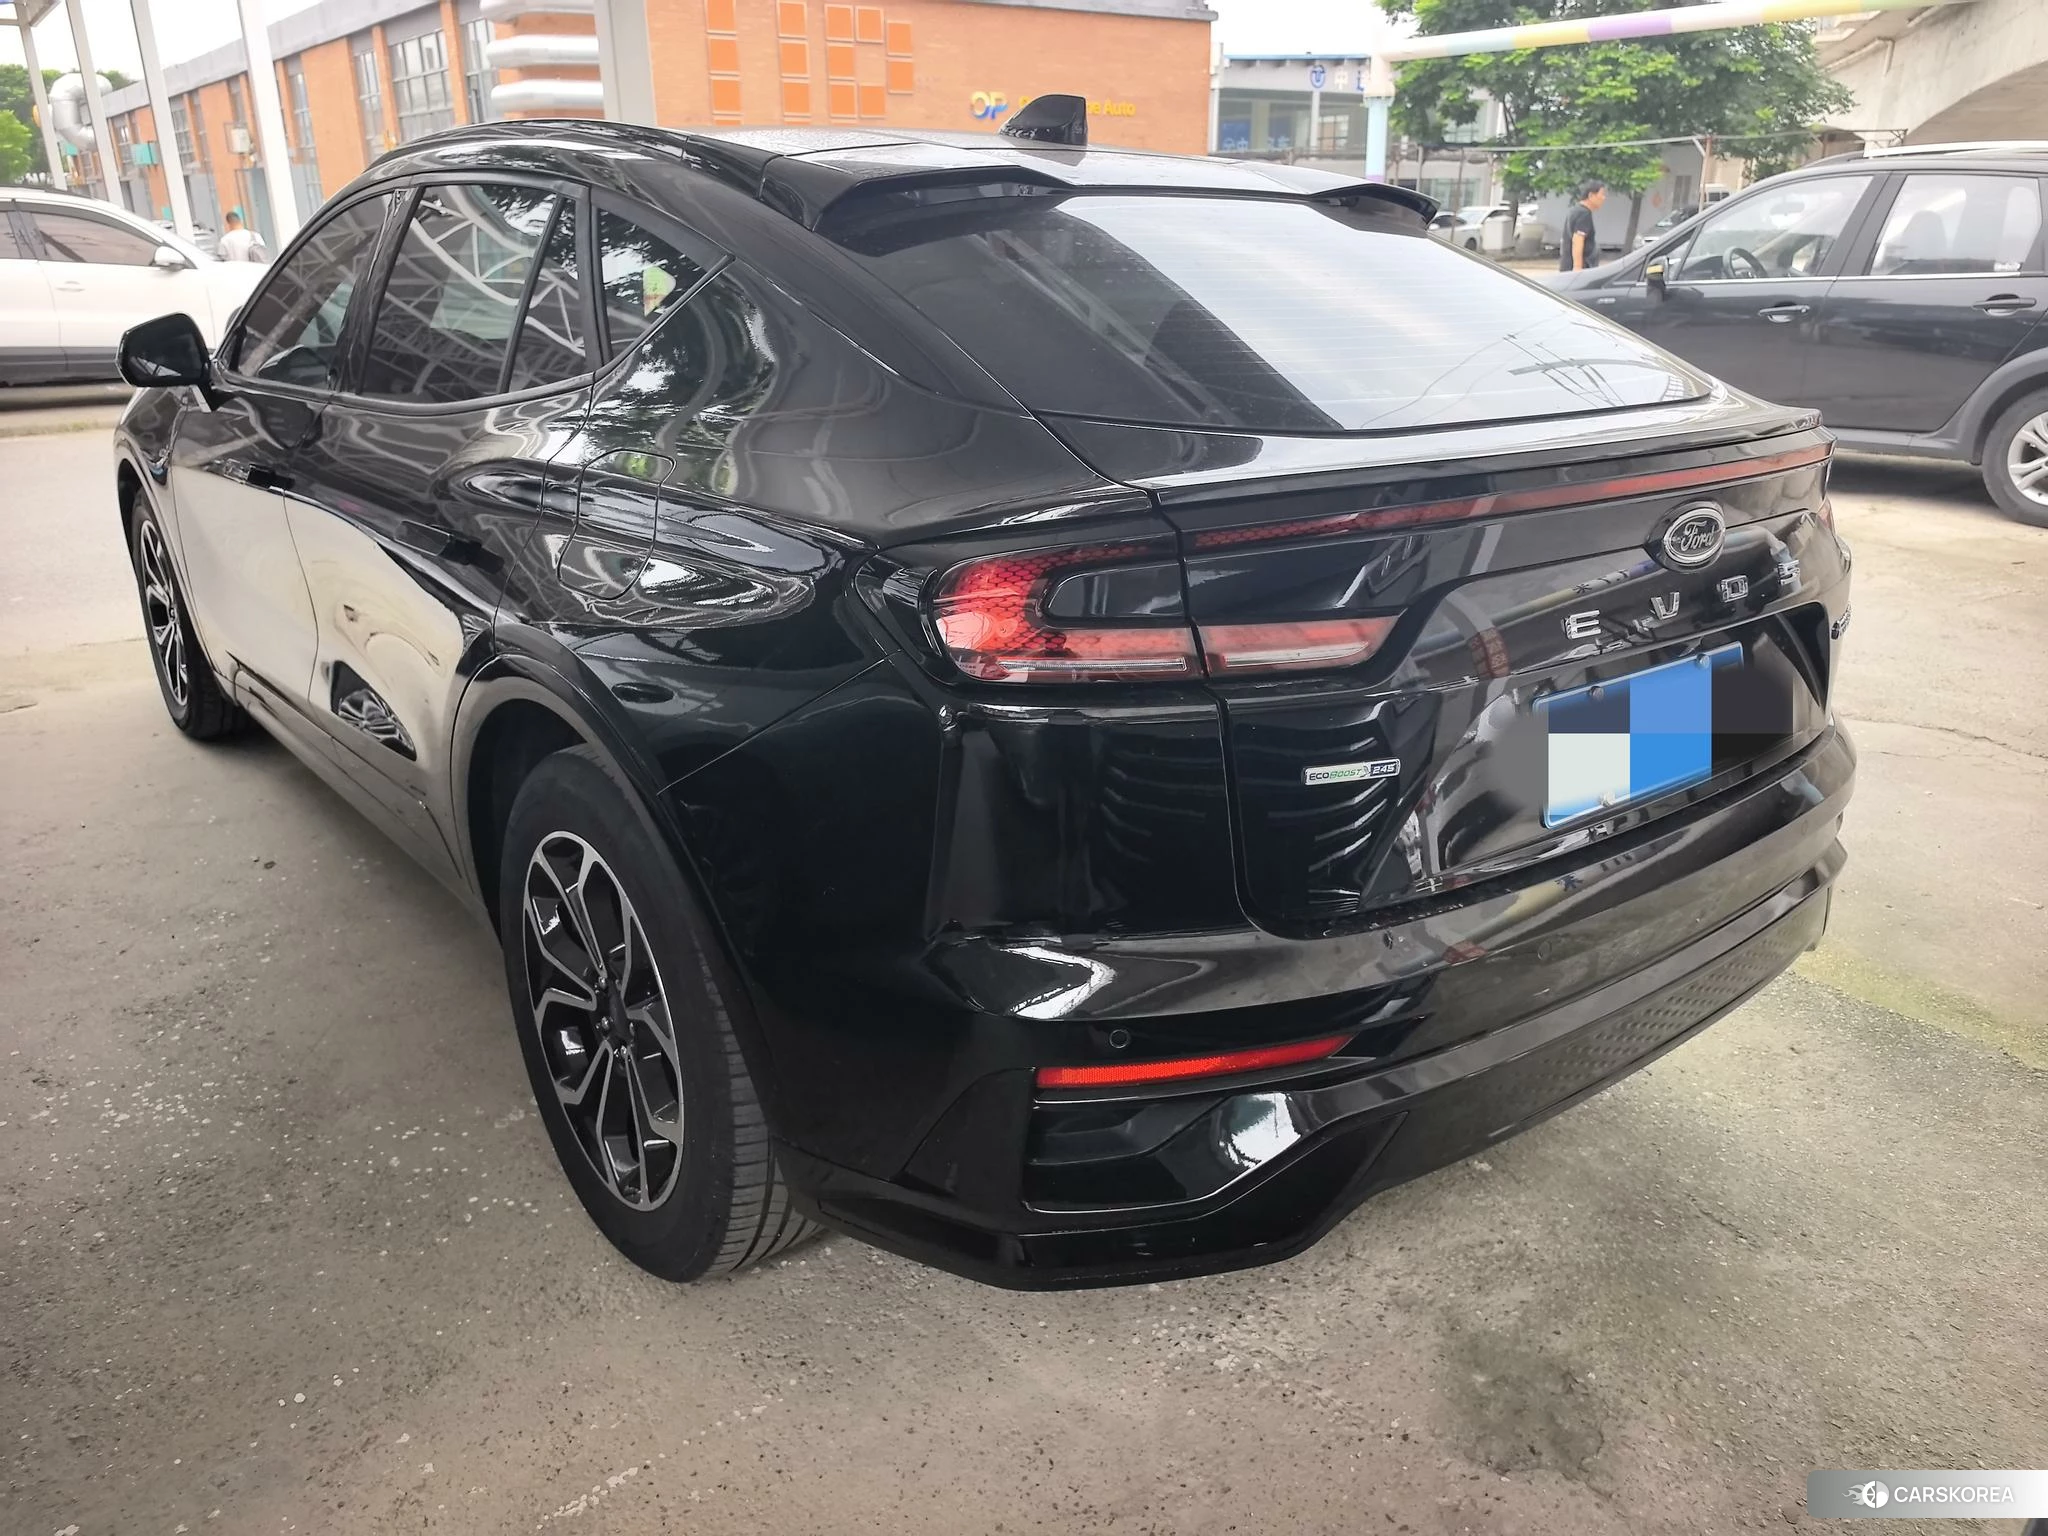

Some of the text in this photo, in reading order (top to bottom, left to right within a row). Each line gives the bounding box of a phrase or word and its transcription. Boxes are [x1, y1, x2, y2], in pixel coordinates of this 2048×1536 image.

[1103, 99, 1136, 117] Auto
[1680, 519, 1717, 551] Ford
[1308, 763, 1396, 781] ECOBOOST 245
